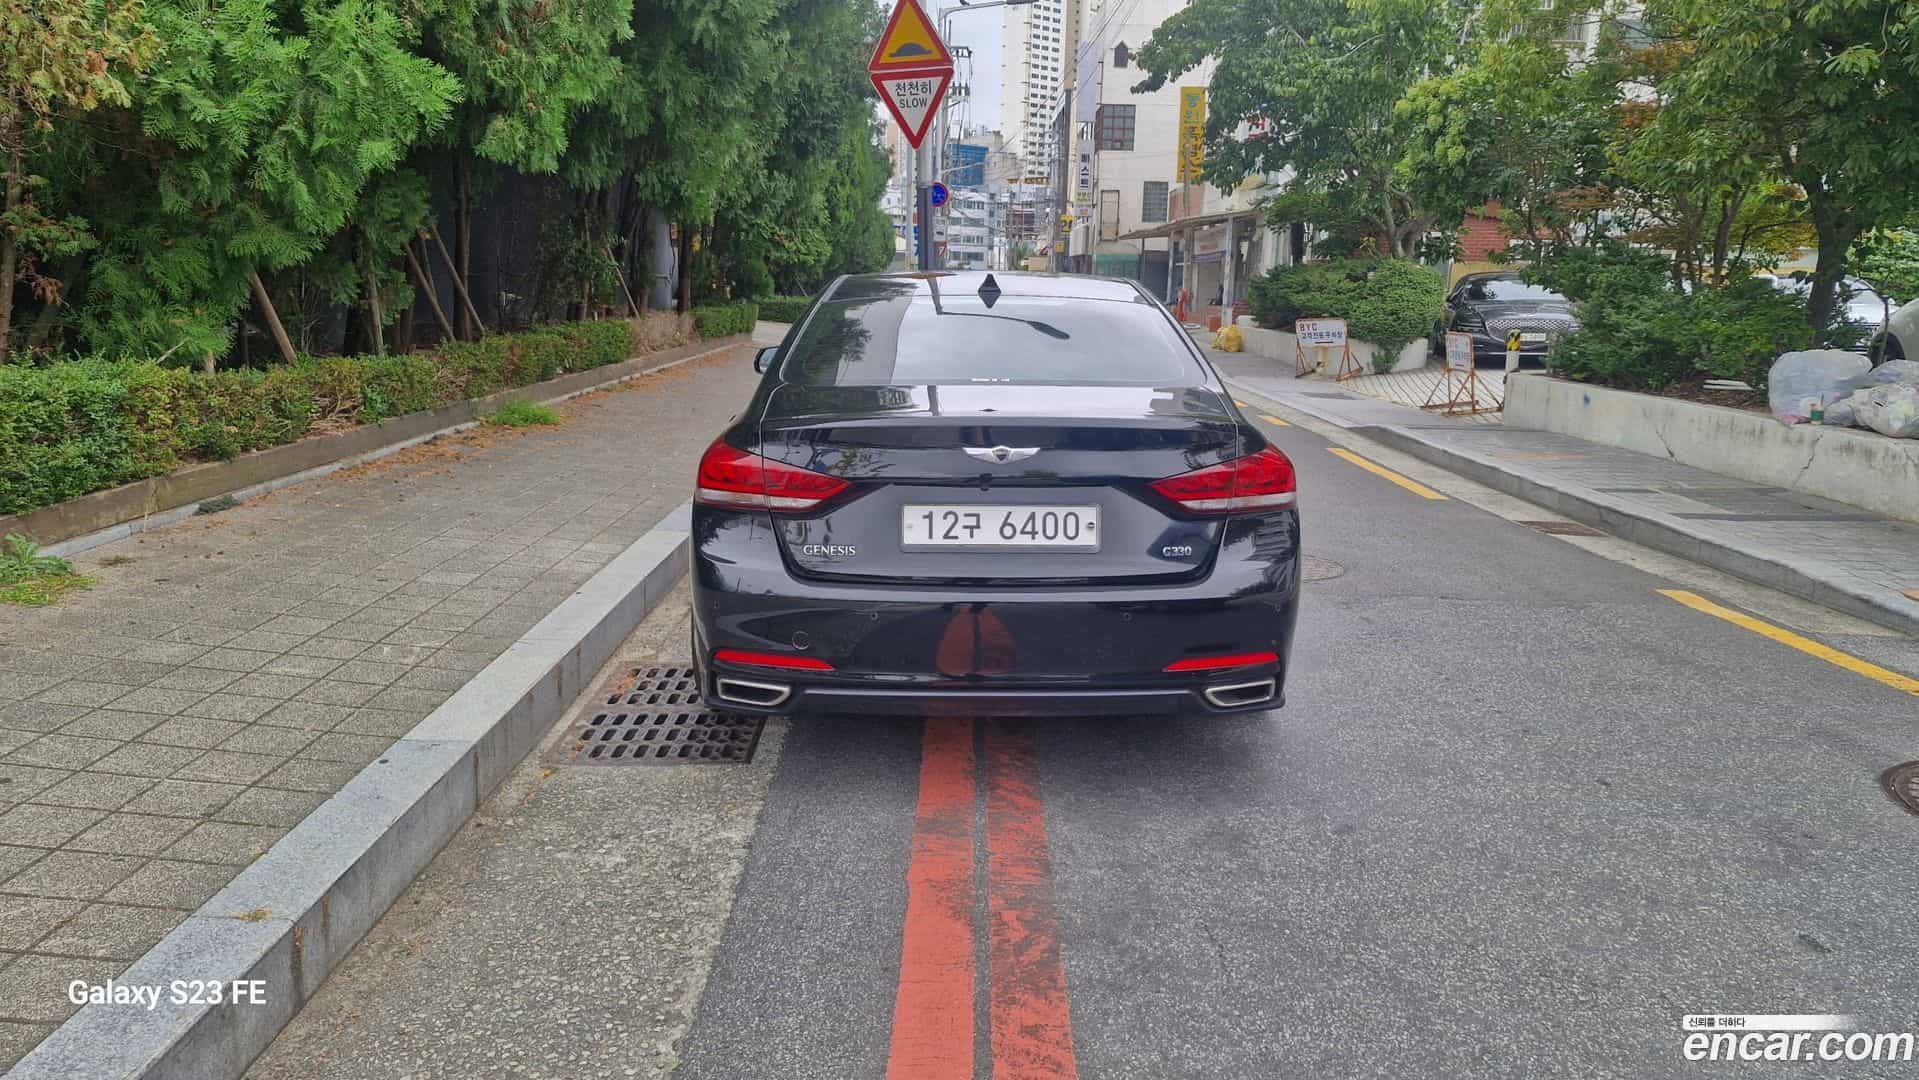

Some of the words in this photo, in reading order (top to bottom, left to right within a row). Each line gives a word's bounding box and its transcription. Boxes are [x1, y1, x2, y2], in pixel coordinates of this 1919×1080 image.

[896, 80, 932, 96] 천천히
[899, 97, 928, 108] SLOW
[1299, 322, 1318, 332] BYC
[922, 510, 981, 540] 12구
[999, 511, 1080, 541] 6400
[803, 544, 856, 556] GENESIS
[1162, 546, 1192, 557] G330
